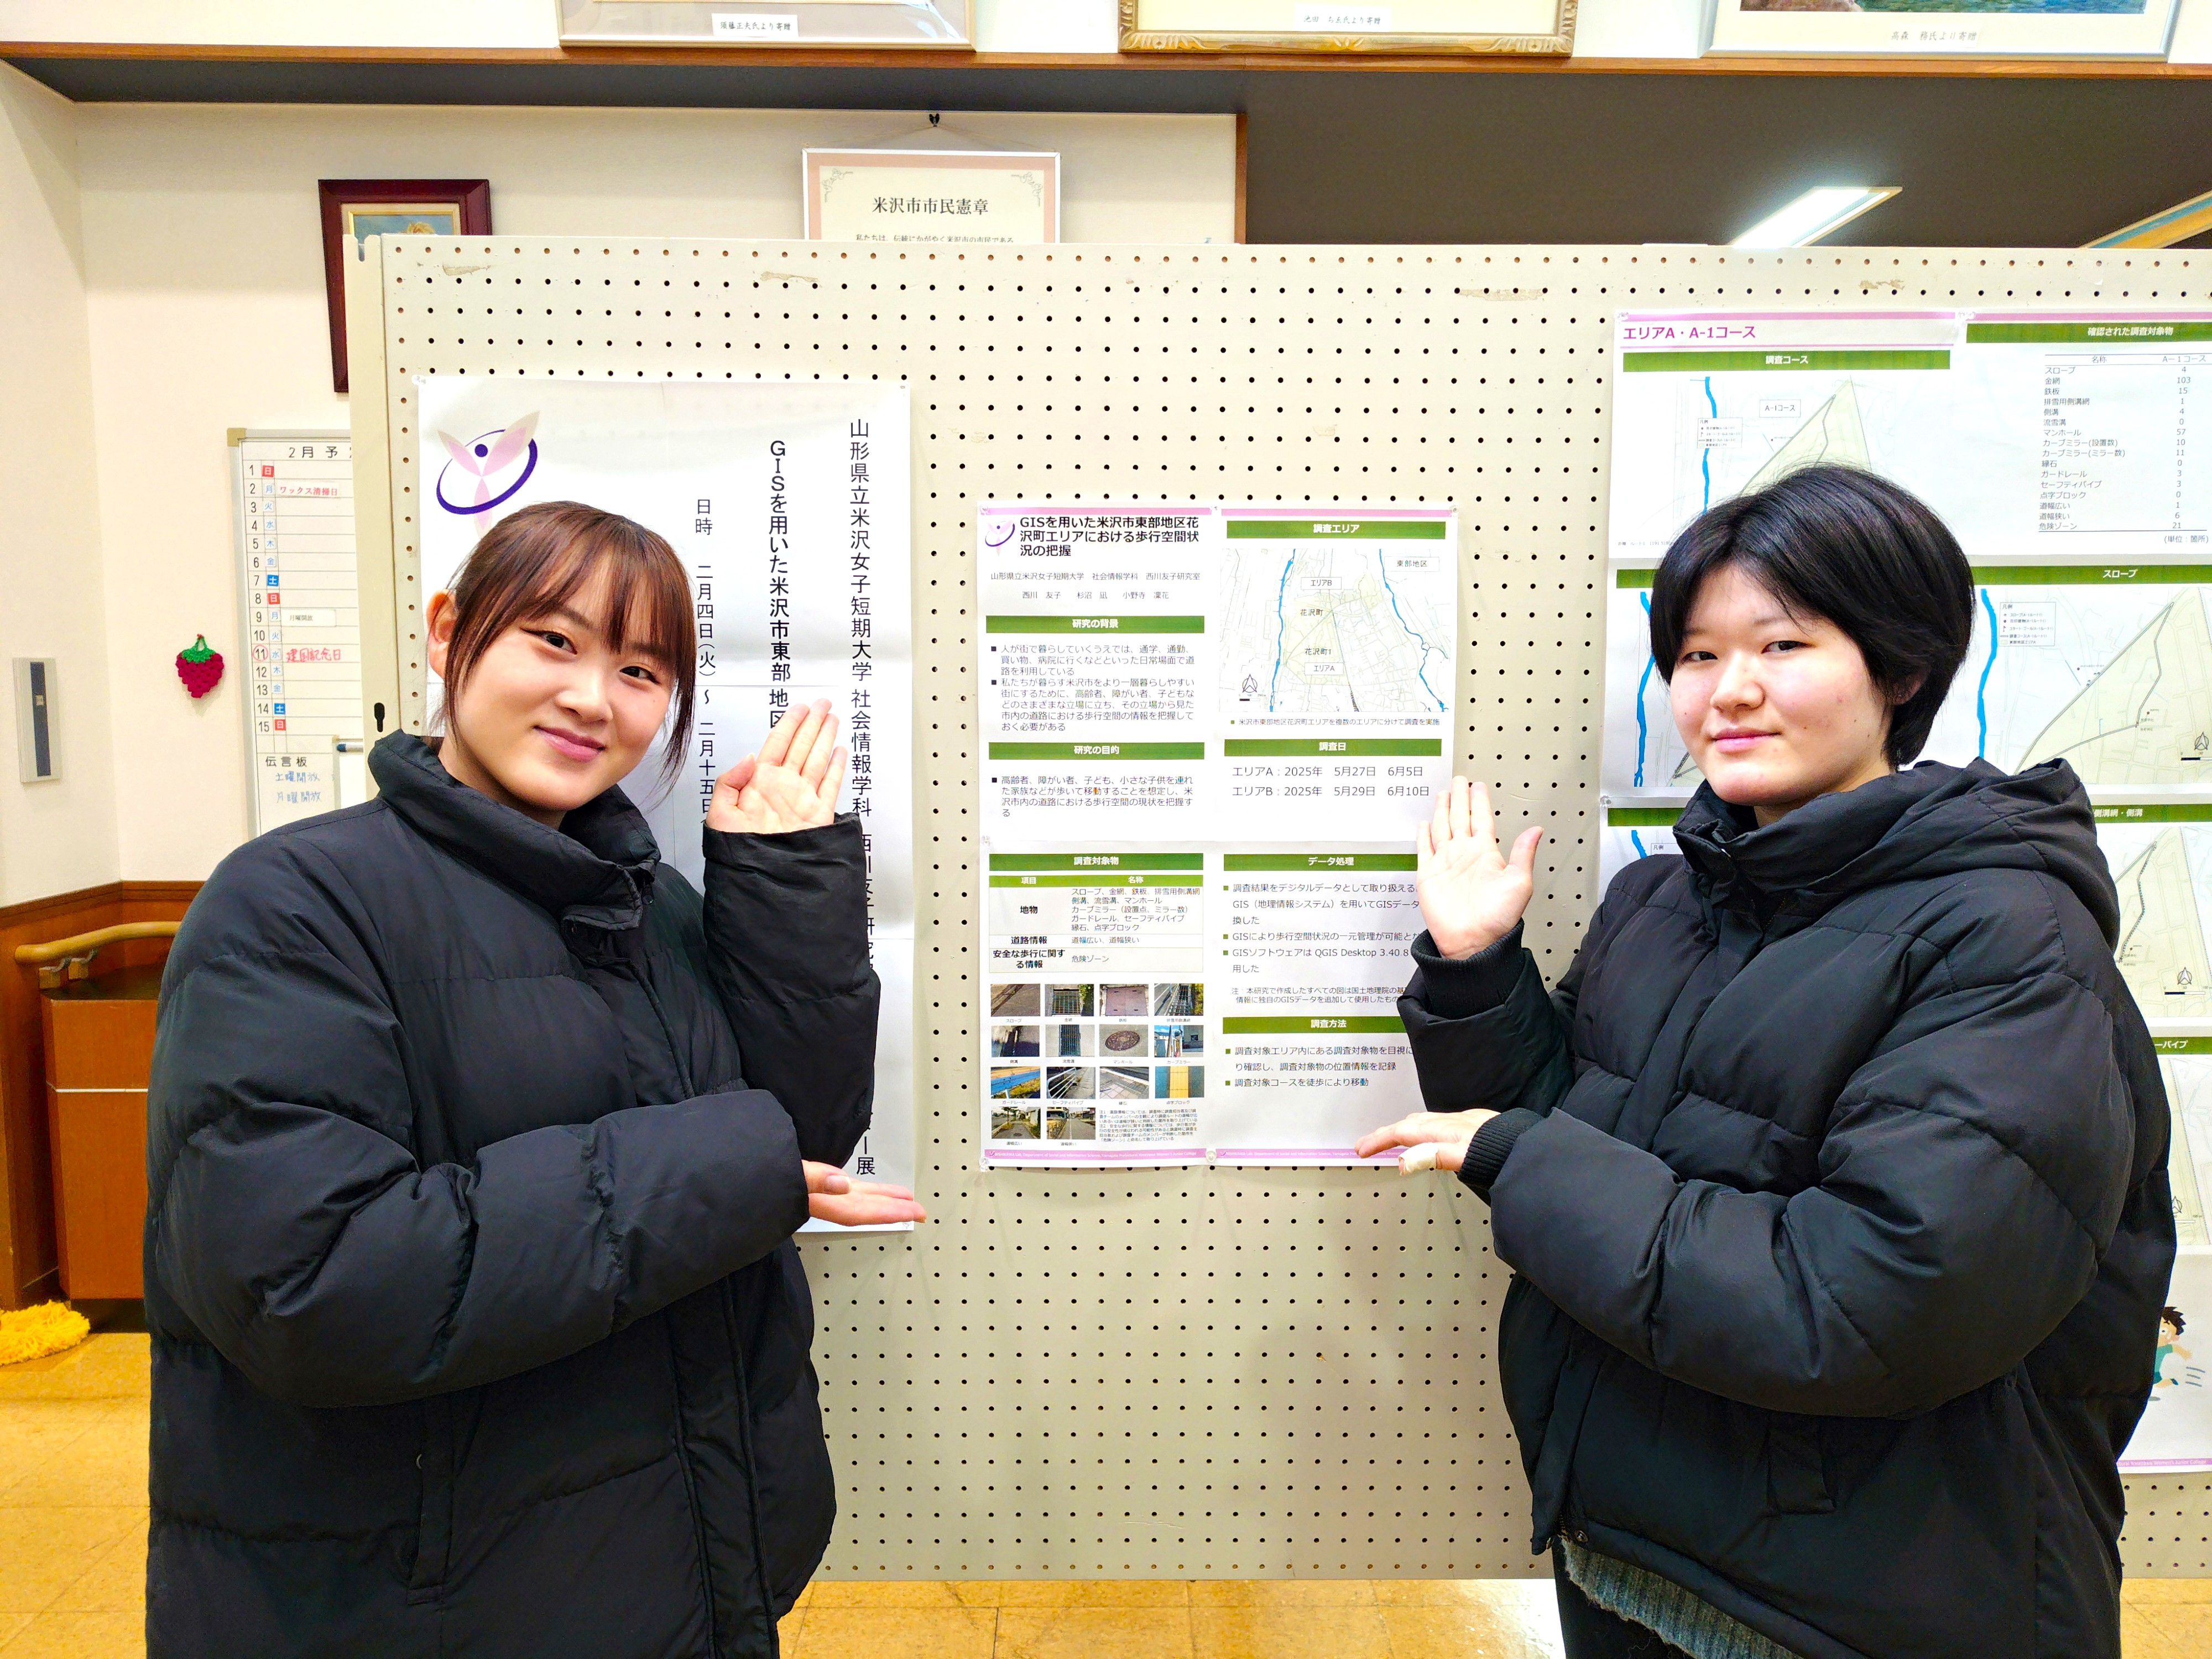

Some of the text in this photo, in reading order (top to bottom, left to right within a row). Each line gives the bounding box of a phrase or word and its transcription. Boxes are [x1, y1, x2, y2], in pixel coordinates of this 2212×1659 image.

[1303, 15, 1319, 23] 池田
[873, 197, 989, 216] 米沢市市民憲章
[1623, 325, 1756, 340] エリアA・A-1コース
[2088, 326, 2173, 336] 確認された調査対象物
[1766, 355, 1808, 365] 調査コース
[249, 465, 254, 476] 1
[250, 483, 255, 494] 2
[251, 502, 257, 513] 3
[694, 498, 714, 535] 日時
[252, 521, 258, 530] 4
[1020, 517, 1199, 529] GISを用いた米沢市東部地区花
[1313, 524, 1360, 534] 調査エリア
[1020, 530, 1199, 543] 沢町エリアにおける歩行空間状
[253, 539, 259, 549] 5
[1020, 544, 1071, 557] 況の把握
[253, 557, 259, 567] 6
[1397, 560, 1428, 568] 東部地区
[2103, 570, 2138, 578] スロープ
[253, 576, 277, 586] 7 土
[255, 593, 261, 604] 8
[256, 612, 262, 622] 9
[1072, 618, 1119, 628] 研究の背景
[254, 630, 265, 641] 10
[255, 648, 265, 659] 11
[256, 667, 267, 677] 12
[1001, 667, 1074, 676] 路を利用している
[257, 685, 268, 696] 13
[258, 703, 269, 714] 14
[1001, 711, 1194, 721] 市内の道路における歩行空間の情報を把握して
[259, 722, 270, 732] 15
[1001, 723, 1066, 732] おく必要がある
[1074, 745, 1119, 755] 研究の目的
[1319, 742, 1347, 752] 調査日
[266, 757, 307, 766] 伝言板
[1334, 766, 1376, 777] 5月27日
[1388, 766, 1423, 777] 6月5日
[1334, 786, 1376, 797] 5月29日
[1387, 786, 1430, 797] 6月10日
[1002, 809, 1011, 817] る
[1074, 856, 1119, 866] 調査対象物
[1308, 857, 1354, 867] データ処理
[1233, 883, 1418, 893] 調査結果をデジタルデータとして取り扱える
[1020, 905, 1038, 915] 地物
[1232, 916, 1260, 925] 換した
[1011, 936, 1047, 945] 道路情報
[993, 949, 1066, 958] 安全な歩行に関す
[1071, 954, 1109, 963] 危険ゾーン
[1232, 948, 1409, 959] GISソフトウェアは QGIS Desktop 3.40.8
[1016, 959, 1044, 969] る情報
[1232, 964, 1260, 973] 用した
[1311, 1019, 1347, 1029] 調査方法
[1235, 1078, 1369, 1088] 調査対象コースを徒歩により移動
